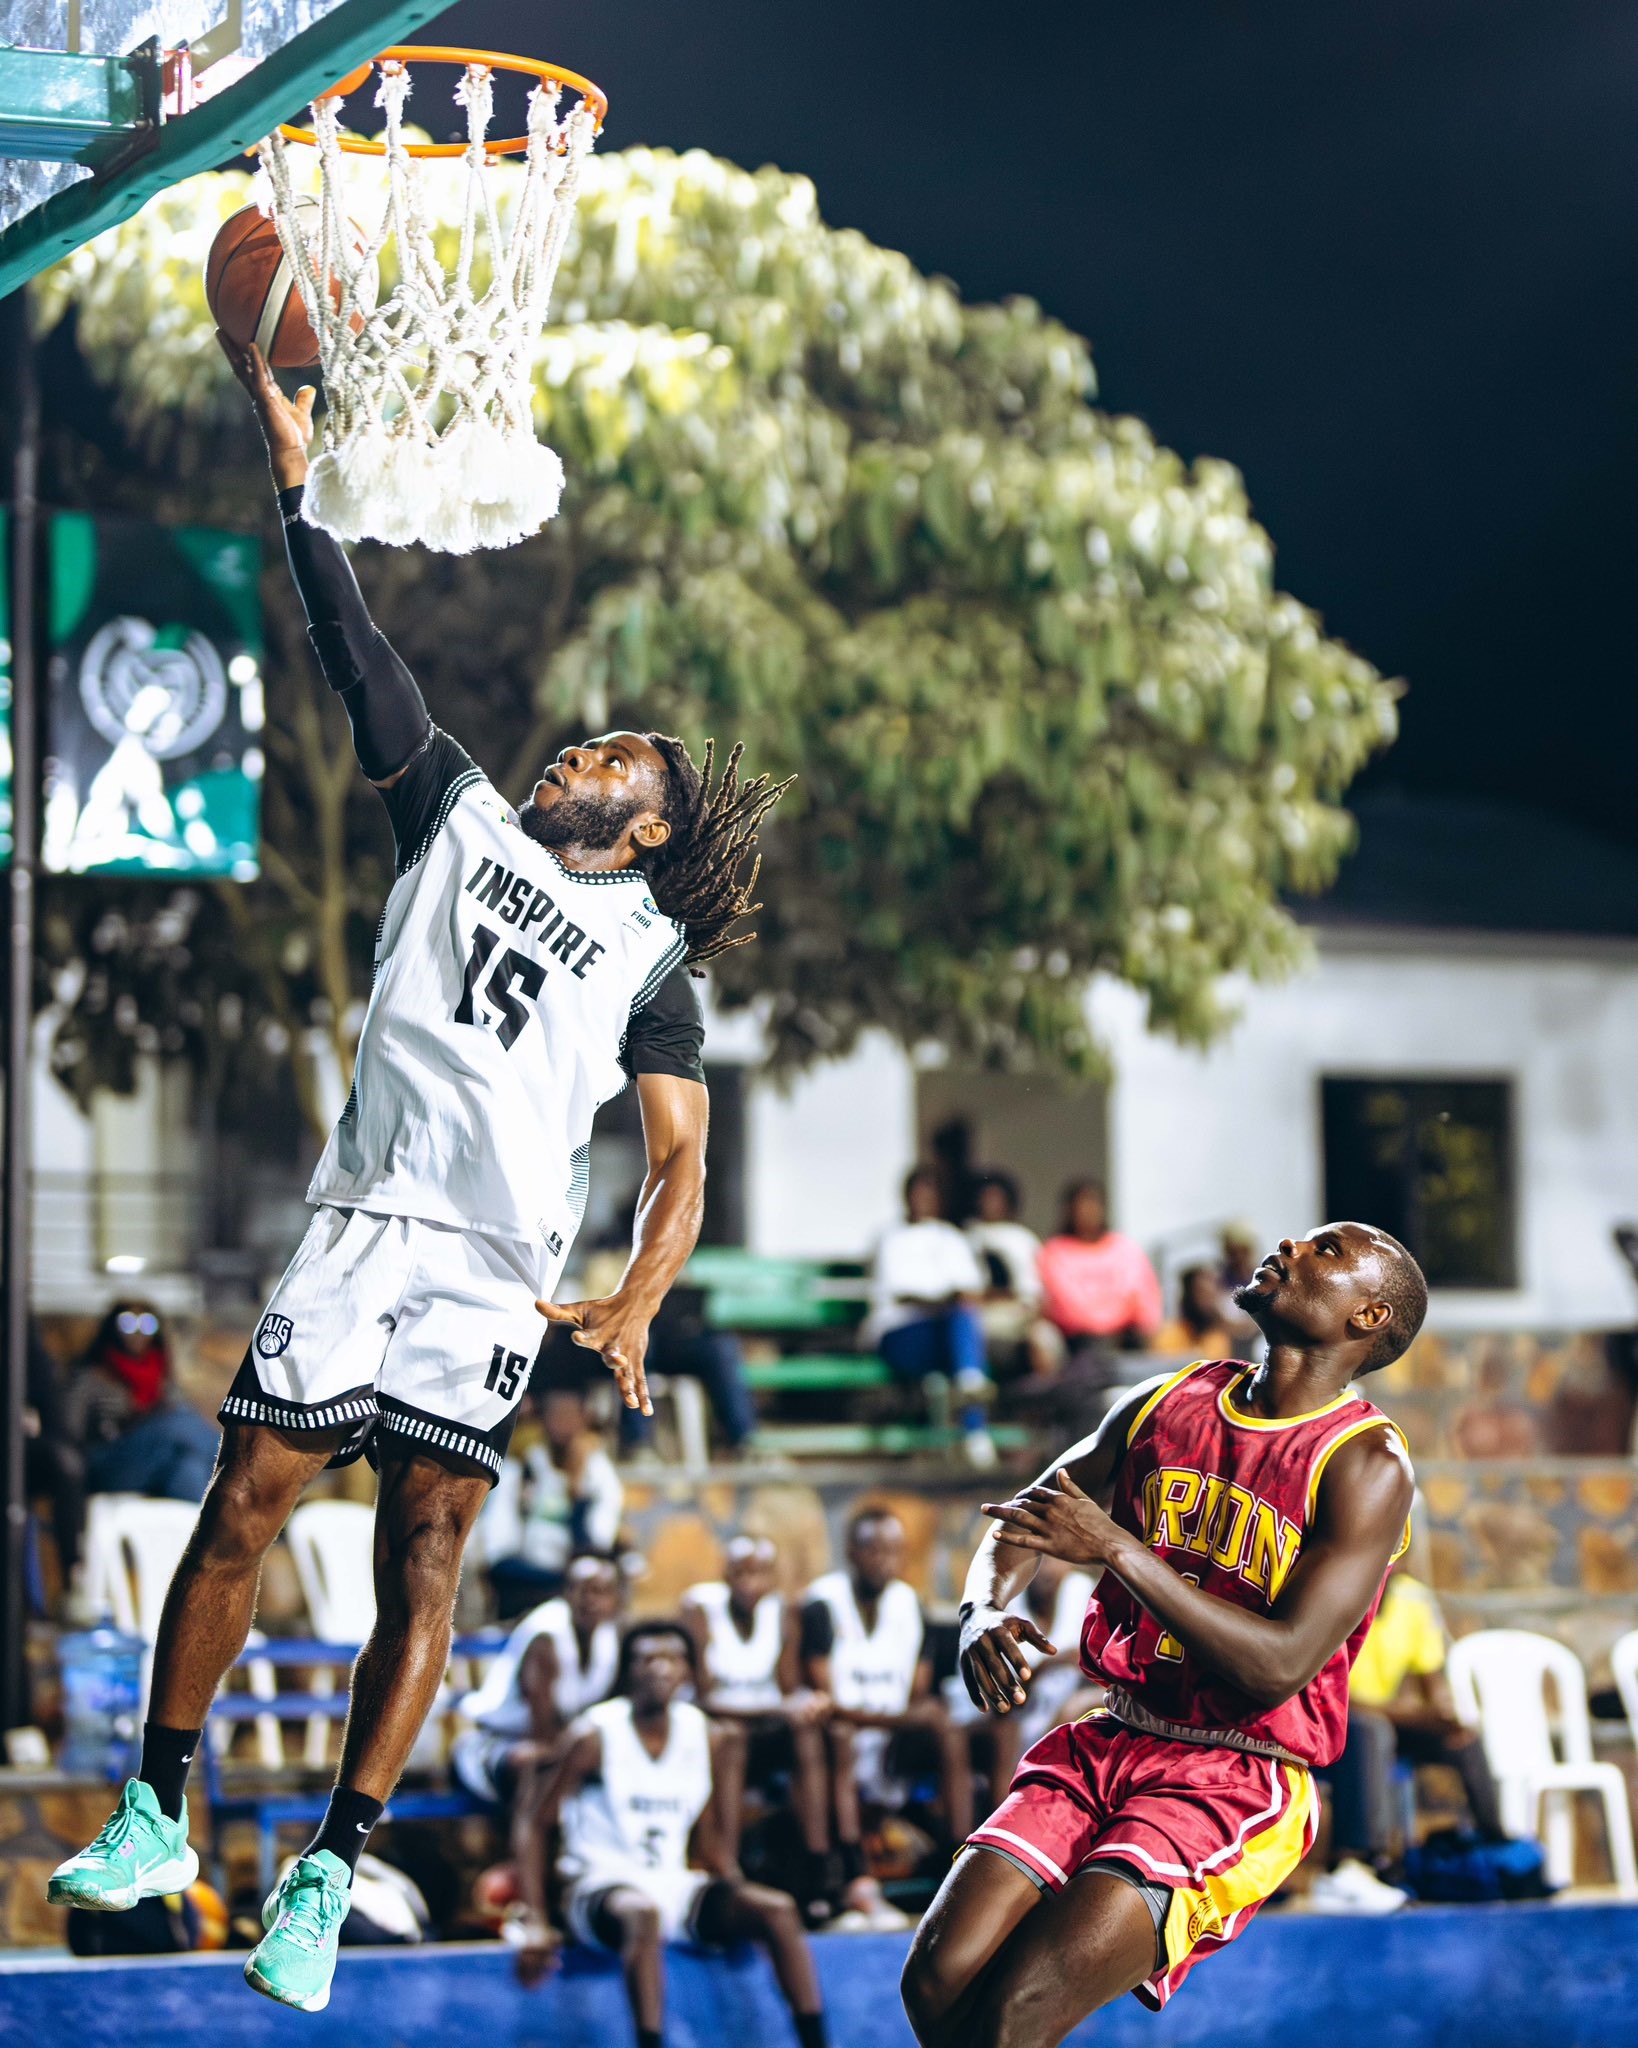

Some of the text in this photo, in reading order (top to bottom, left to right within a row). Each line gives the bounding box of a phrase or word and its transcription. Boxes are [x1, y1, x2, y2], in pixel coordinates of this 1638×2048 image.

[465, 857, 606, 980] INSPIRE
[630, 910, 652, 929] FIBA
[454, 923, 549, 1052] 15
[260, 1315, 291, 1345] AIG
[484, 1343, 529, 1401] 15
[1142, 1467, 1302, 1606] ORION
